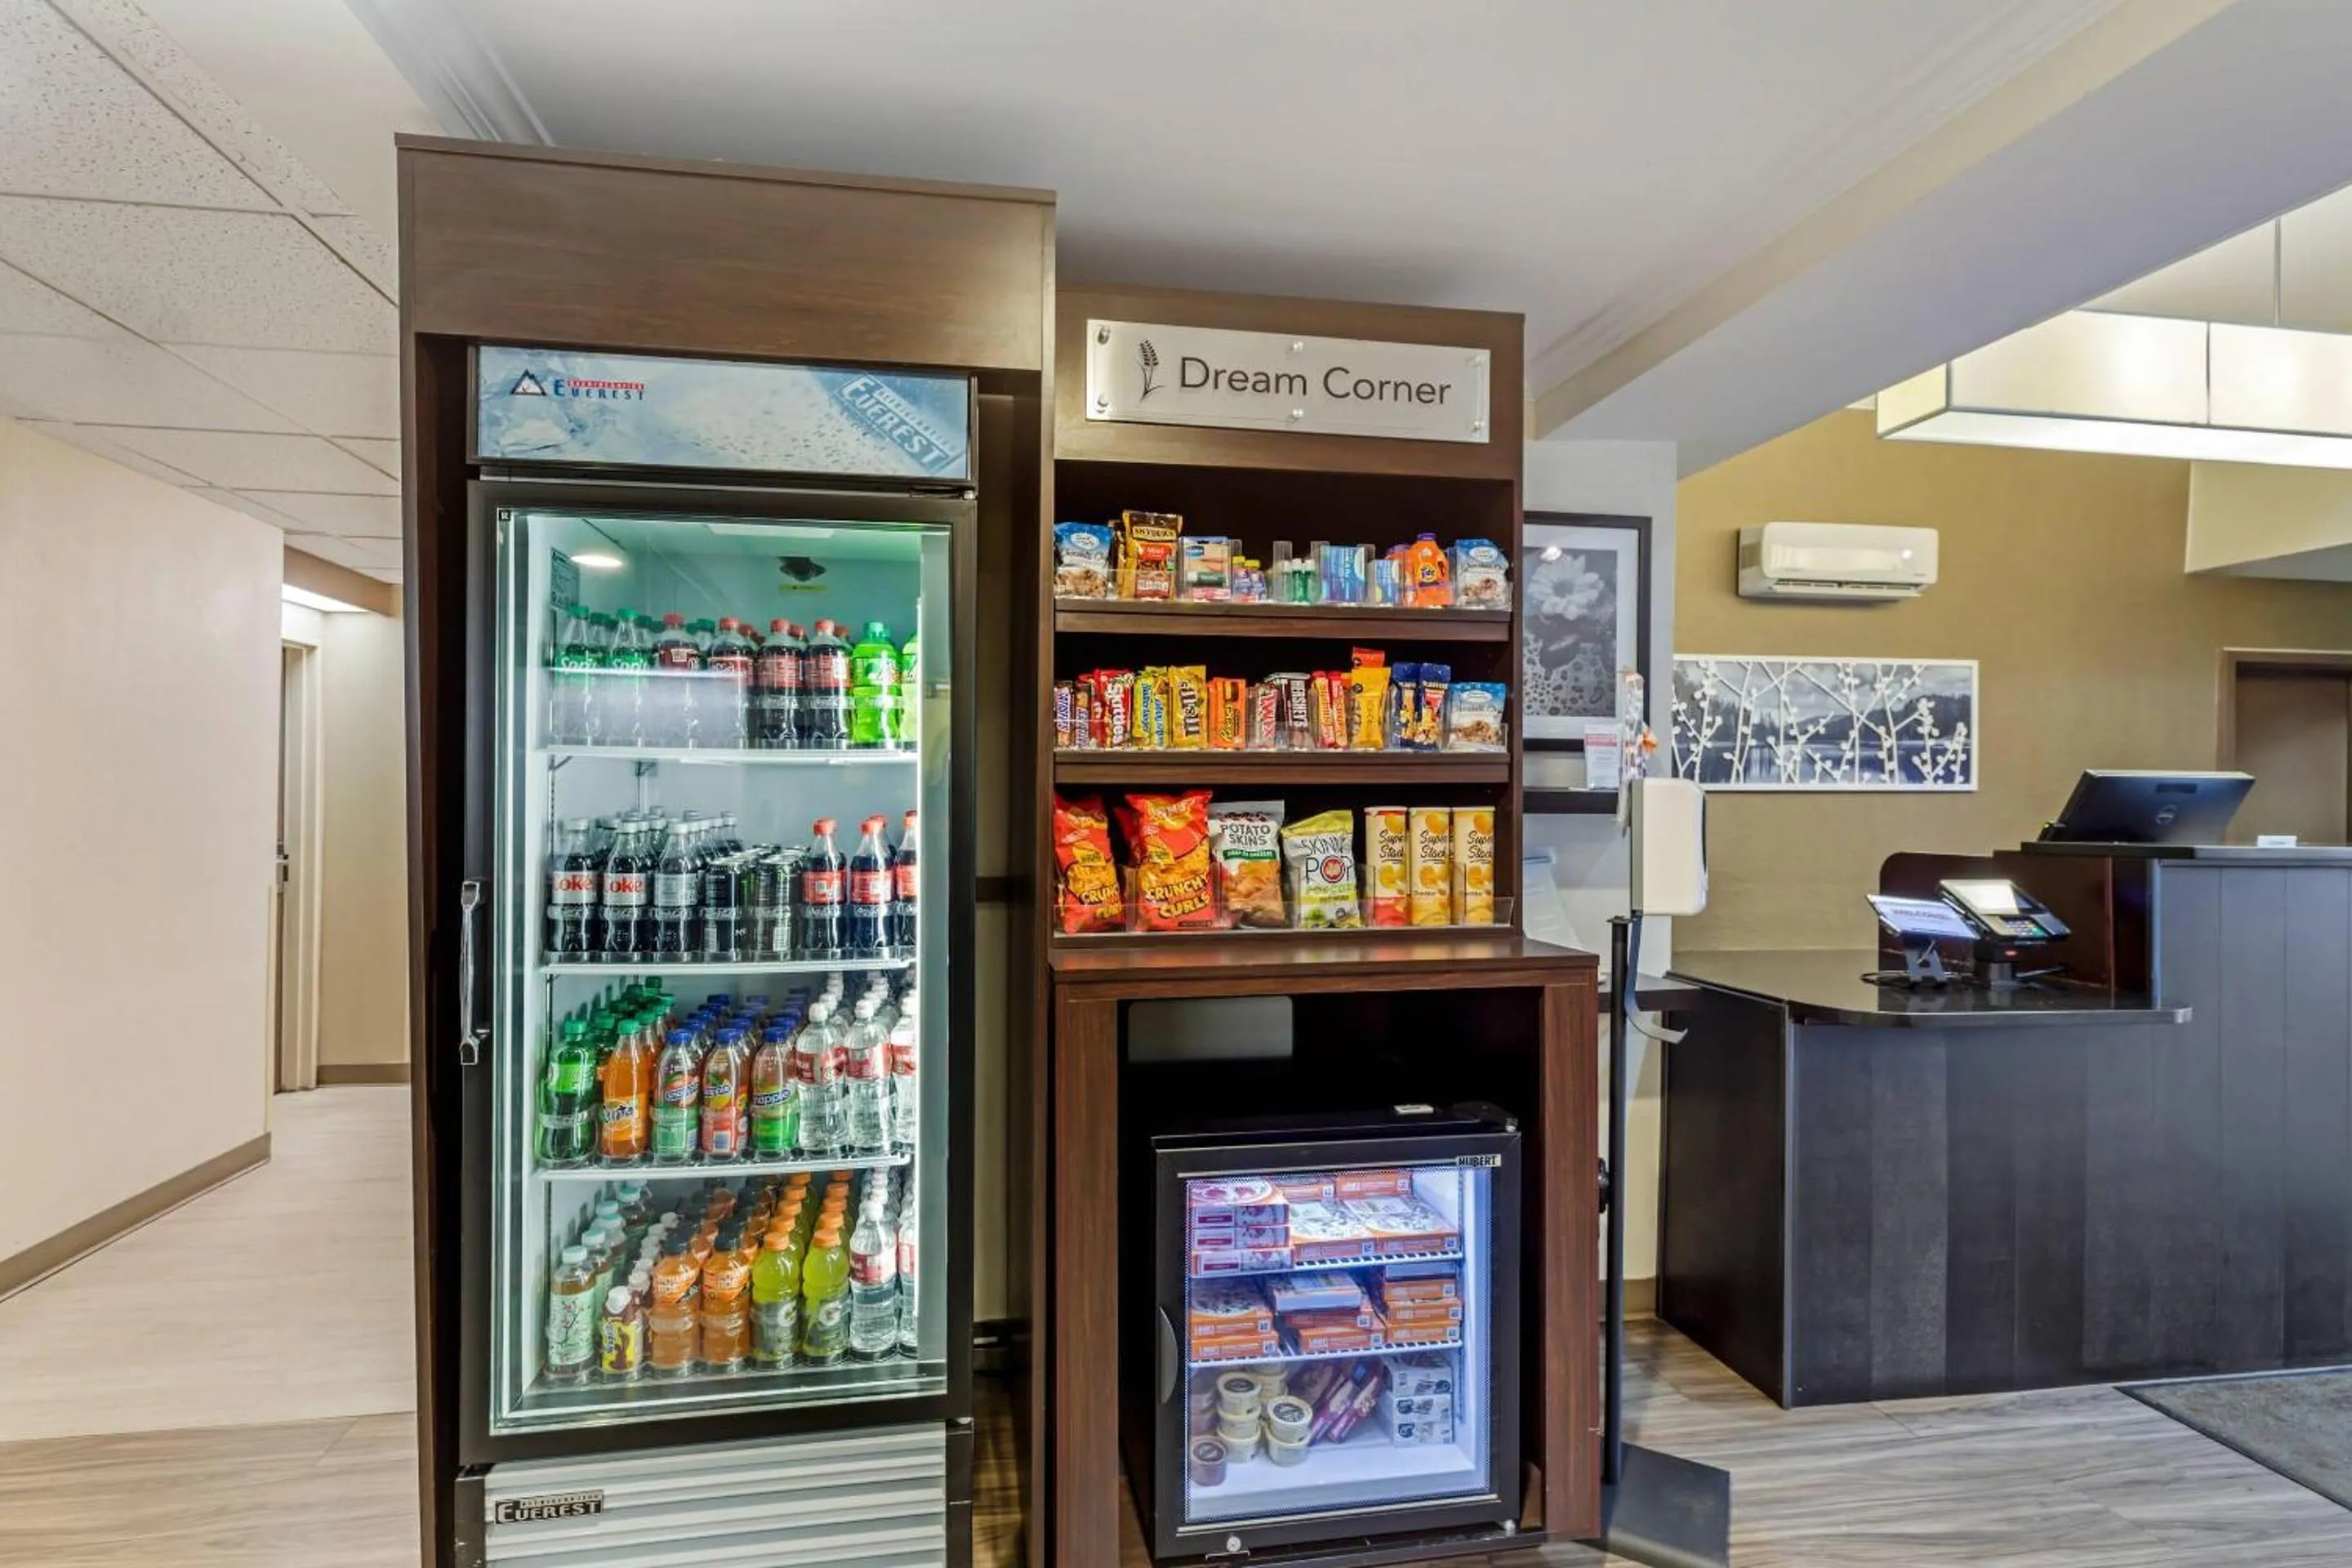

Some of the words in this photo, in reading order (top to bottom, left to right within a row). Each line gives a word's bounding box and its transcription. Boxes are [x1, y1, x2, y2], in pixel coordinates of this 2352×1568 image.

[1180, 356, 1307, 395] Dream
[1323, 367, 1451, 403] Corner
[1220, 823, 1271, 836] POTATO
[1228, 833, 1267, 847] SKINS
[1159, 890, 1209, 919] CURLS
